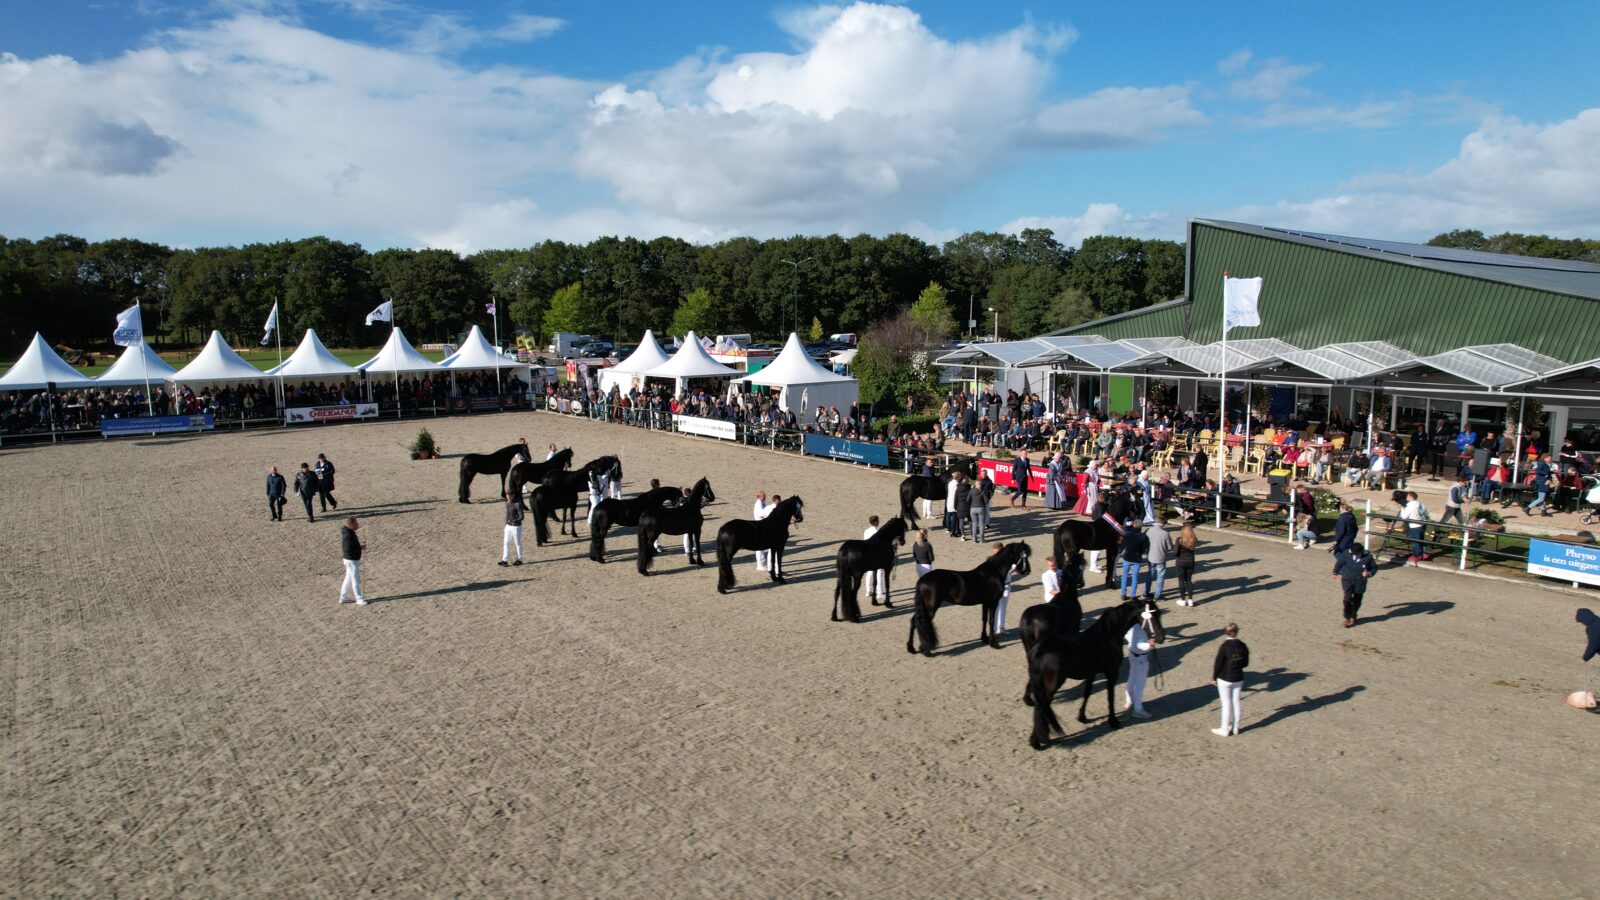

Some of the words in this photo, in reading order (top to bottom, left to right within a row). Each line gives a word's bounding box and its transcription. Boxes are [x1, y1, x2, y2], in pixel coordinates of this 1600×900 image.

[309, 408, 358, 418] GREIDANUS
[996, 464, 1008, 473] EFO
[1565, 549, 1596, 561] Phryso
[1569, 560, 1600, 570] uitgave
